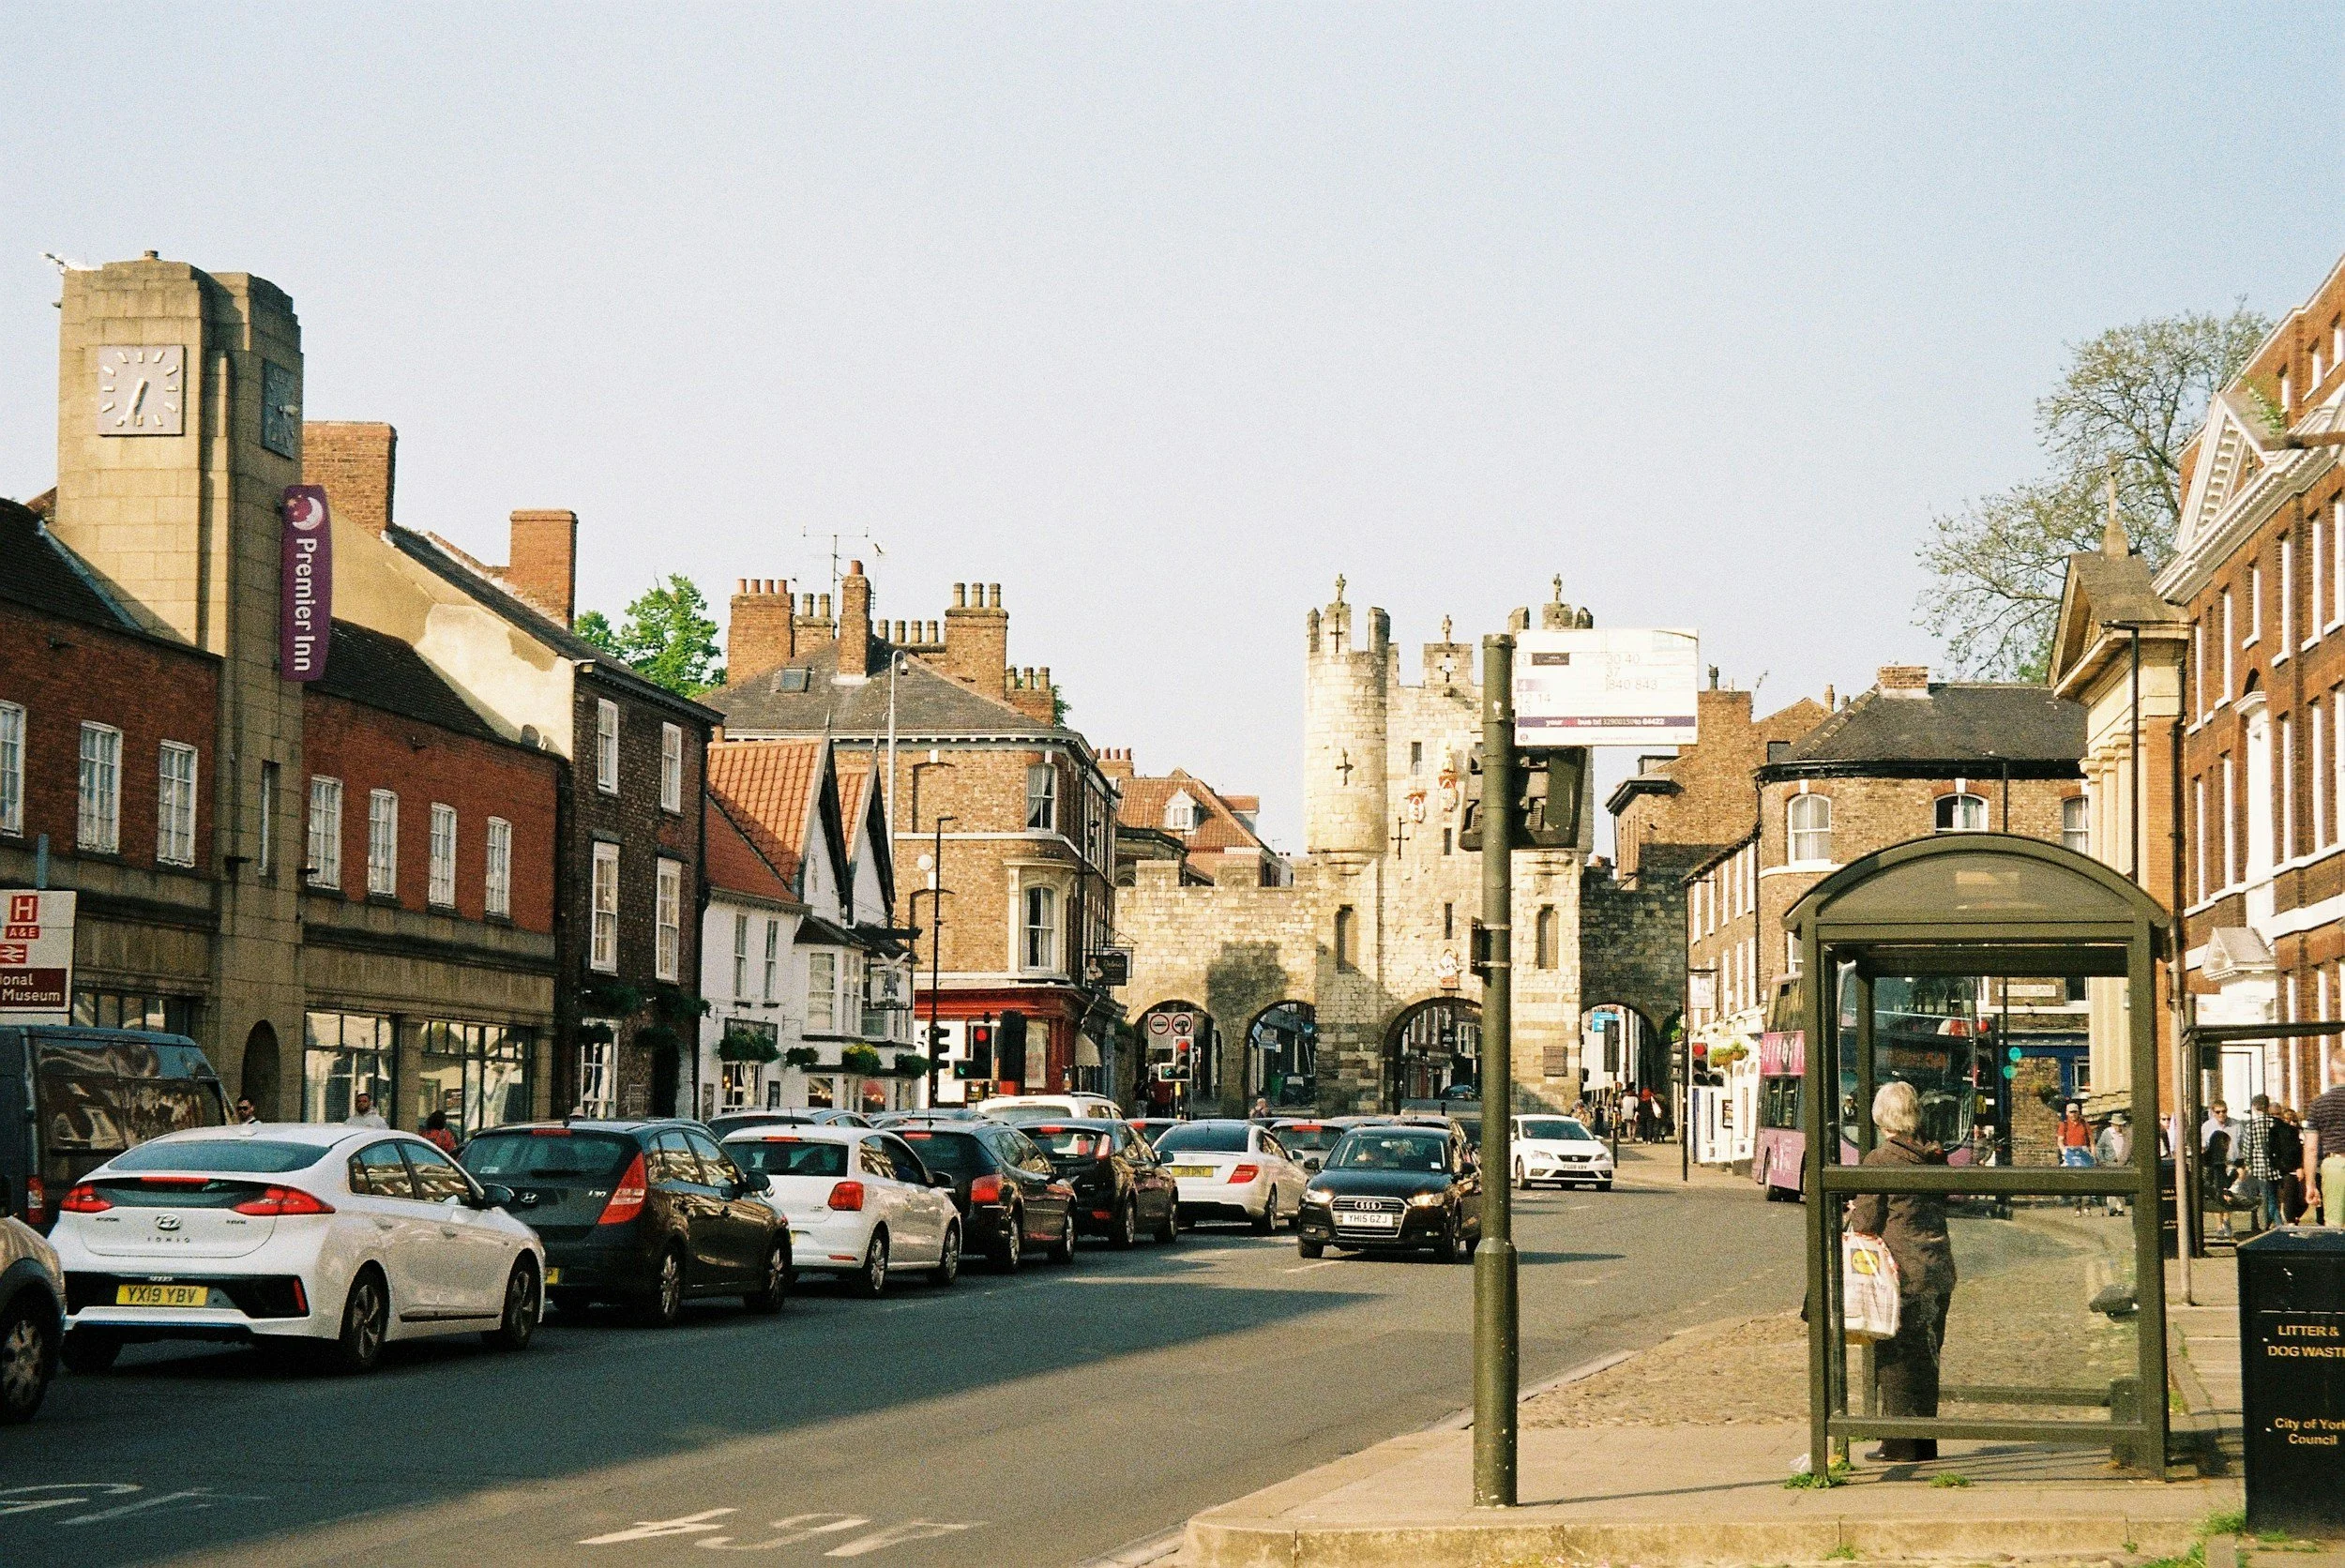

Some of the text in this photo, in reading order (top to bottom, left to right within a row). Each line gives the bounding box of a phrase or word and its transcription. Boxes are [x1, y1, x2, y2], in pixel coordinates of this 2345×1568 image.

[295, 538, 317, 671] Premier Inn
[1606, 654, 1641, 664] 30 40
[1537, 693, 1551, 703] 14
[1546, 718, 1563, 727] your
[15, 897, 34, 921] H
[8, 927, 36, 938] A&E
[2, 988, 60, 1002] Museum
[1349, 1214, 1368, 1223] YH15
[128, 1287, 197, 1304] YX19 YBV
[2277, 1325, 2340, 1337] LITTER &
[2267, 1345, 2300, 1357] DOG
[2274, 1418, 2299, 1431] City
[2303, 1418, 2317, 1429] of
[2288, 1433, 2337, 1446] Council
